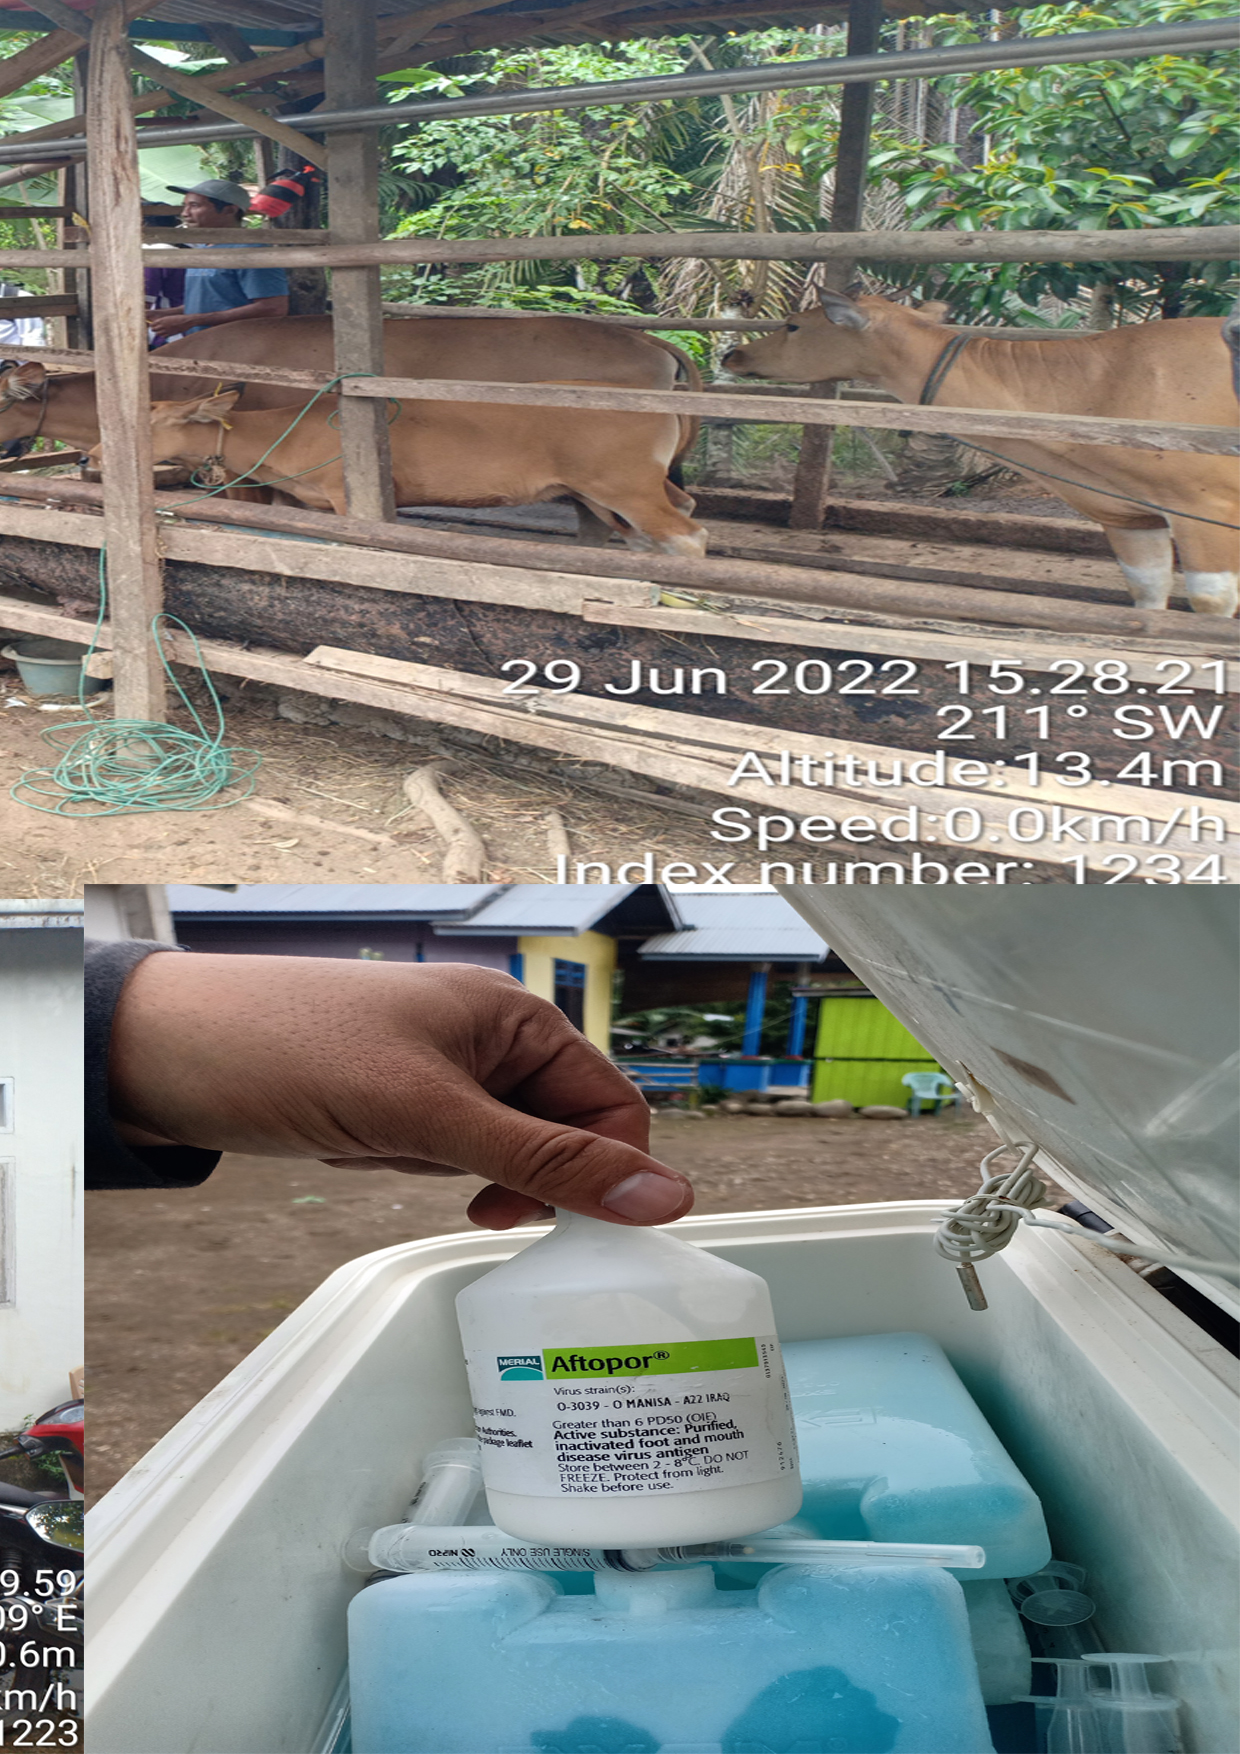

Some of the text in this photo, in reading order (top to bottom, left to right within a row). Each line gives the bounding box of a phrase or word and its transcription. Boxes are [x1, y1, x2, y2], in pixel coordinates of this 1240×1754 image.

[498, 1358, 540, 1366] MERIAL
[553, 1384, 636, 1397] Virus strain(s):
[626, 1397, 672, 1410] MANISA
[683, 1394, 703, 1405] A22
[706, 1392, 731, 1403] IRAQ
[552, 1411, 717, 1430] Greater than 6 PD50 (OIE)
[554, 1419, 738, 1441] Active substance: Purified,
[556, 1429, 745, 1451] inactivated foot and mouth
[557, 1446, 710, 1463] disease virus antigen
[558, 1463, 590, 1473] Store
[593, 1461, 649, 1472] between
[653, 1460, 661, 1469] 2
[703, 1454, 723, 1465] DO
[726, 1450, 749, 1461] NOT
[560, 1464, 725, 1483] FREEZE. Protect from light.
[561, 1481, 674, 1493] Shake before use.
[428, 1549, 459, 1557] NIPRO
[501, 1548, 591, 1557] SINGLE USE ONLY
